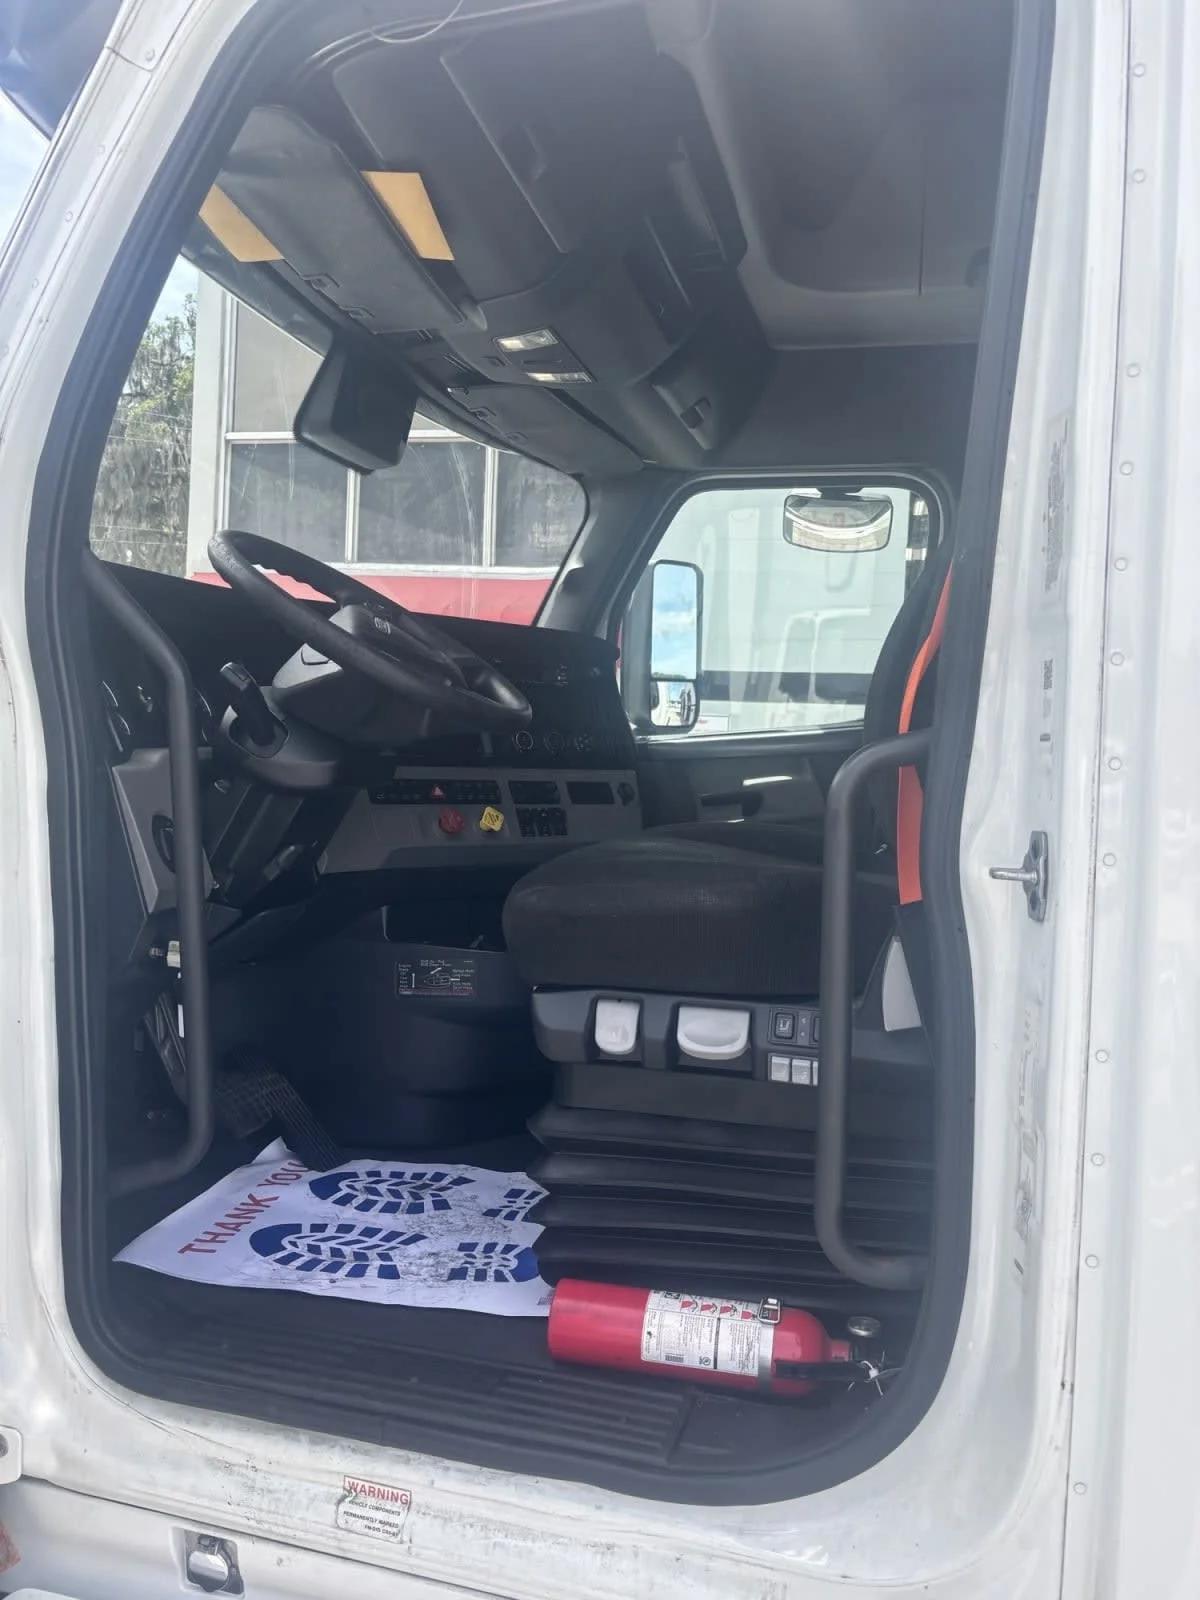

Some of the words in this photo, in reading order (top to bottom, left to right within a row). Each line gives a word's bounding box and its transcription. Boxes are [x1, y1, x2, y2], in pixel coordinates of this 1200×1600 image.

[177, 1193, 280, 1254] THANK
[256, 1161, 310, 1187] YOU
[348, 1480, 409, 1504] WARNING
[343, 1511, 378, 1523] PERMANENTLY
[368, 1504, 401, 1516] COMPONENTS
